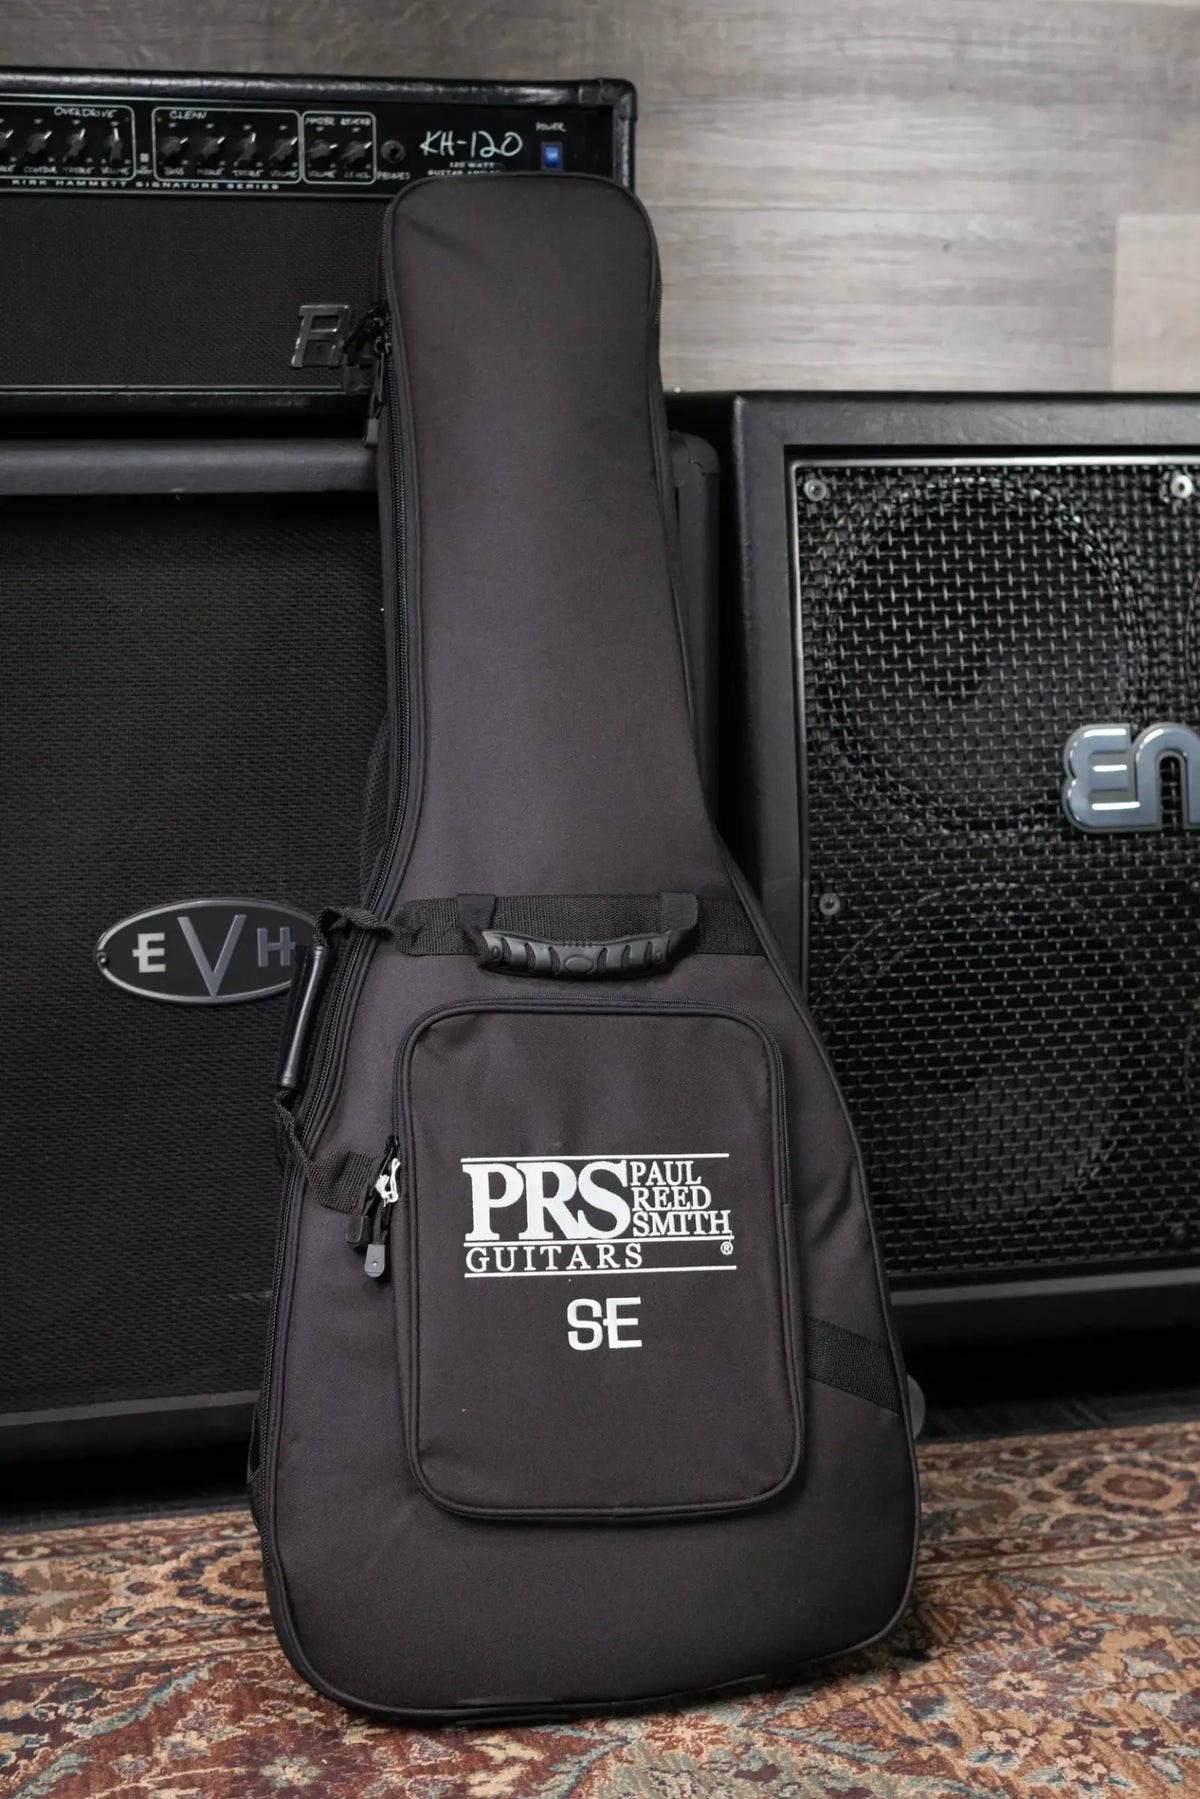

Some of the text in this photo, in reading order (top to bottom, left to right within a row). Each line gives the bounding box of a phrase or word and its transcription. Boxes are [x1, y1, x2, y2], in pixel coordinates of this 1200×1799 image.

[53, 106, 119, 119] OVERDRIVE
[169, 110, 207, 120] CLEAN
[304, 116, 336, 126] MASTER
[535, 122, 566, 132] POWER
[419, 130, 523, 158] KH-120
[135, 181, 219, 189] SIGNATURE
[132, 914, 296, 1000] EVH
[629, 1160, 702, 1187] PAUL
[462, 1160, 631, 1241] PRS
[631, 1185, 712, 1212] REED
[632, 1209, 733, 1237] SMITH
[465, 1242, 643, 1273] GUITARS
[567, 1296, 642, 1351] SE
